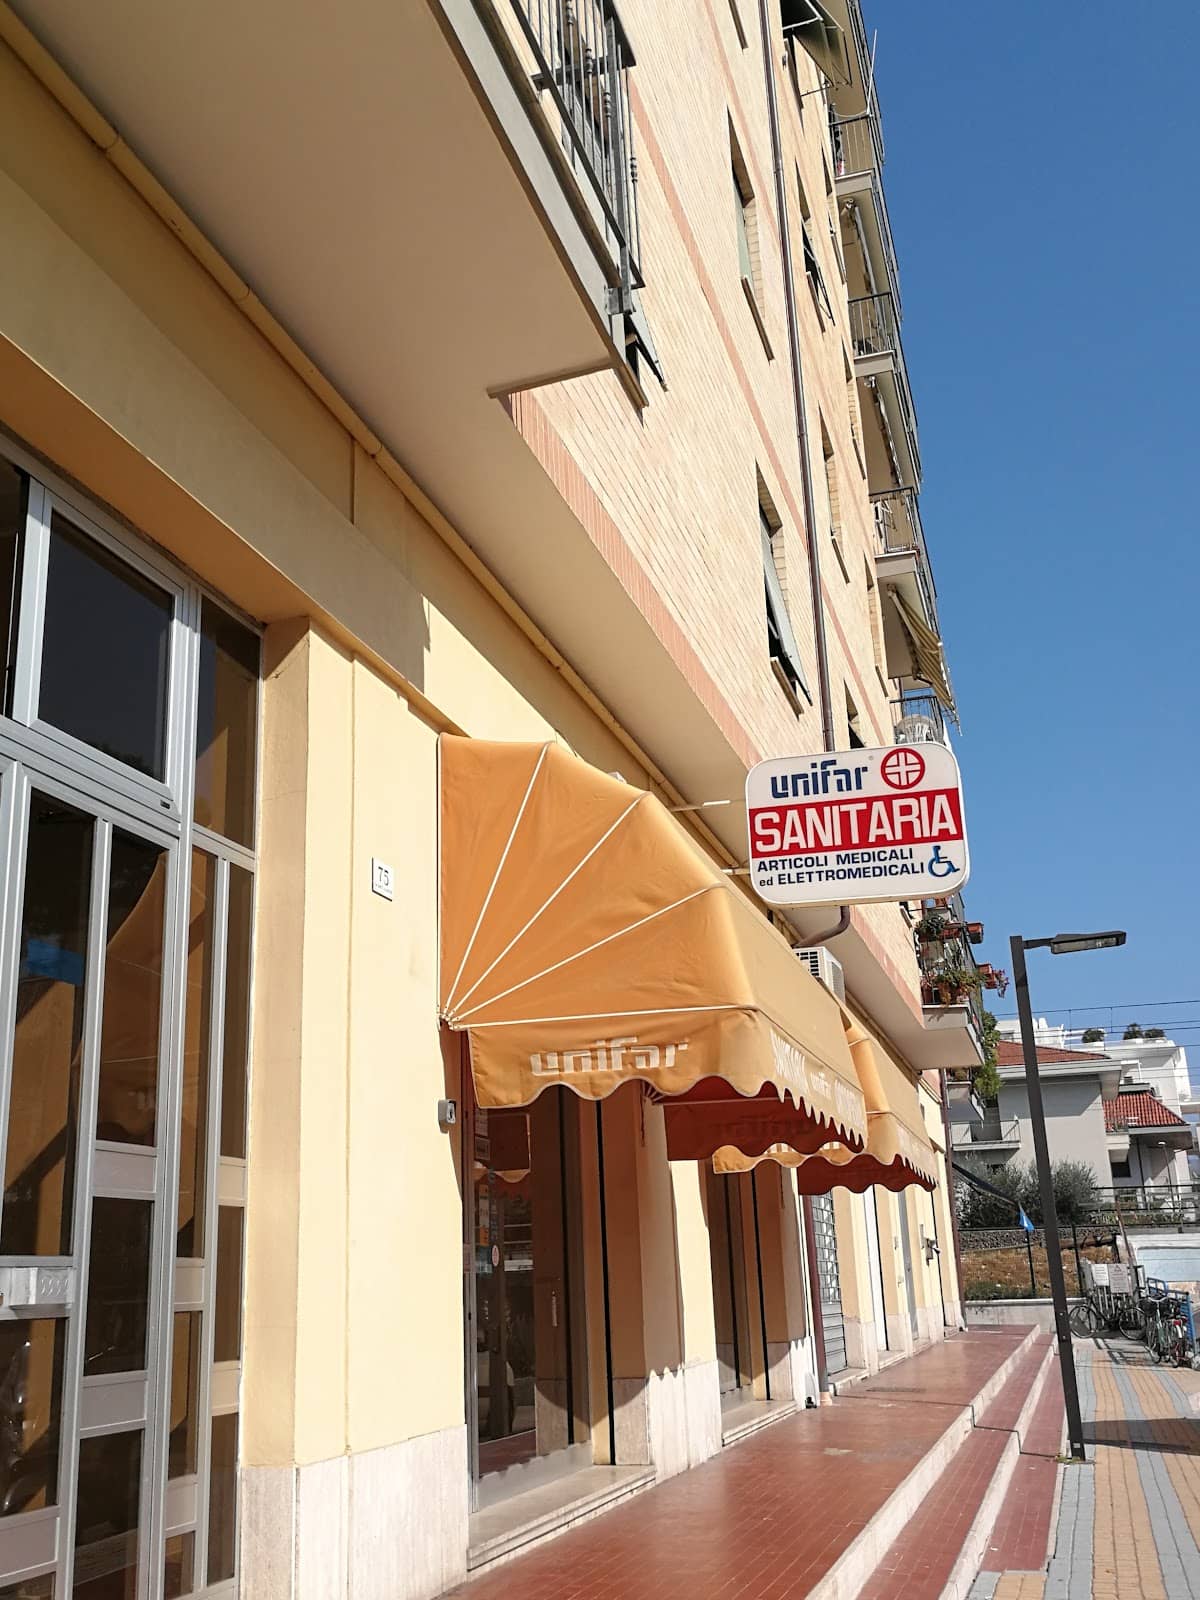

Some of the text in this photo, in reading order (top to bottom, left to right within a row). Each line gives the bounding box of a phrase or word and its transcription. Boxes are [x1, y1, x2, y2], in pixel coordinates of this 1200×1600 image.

[771, 759, 869, 798] unifar
[754, 793, 958, 852] SANITARIA
[757, 847, 913, 872] ARTICOLI MEDICALI
[759, 862, 924, 887] ed ELETTROMEDICALI
[530, 1036, 690, 1077] unifar
